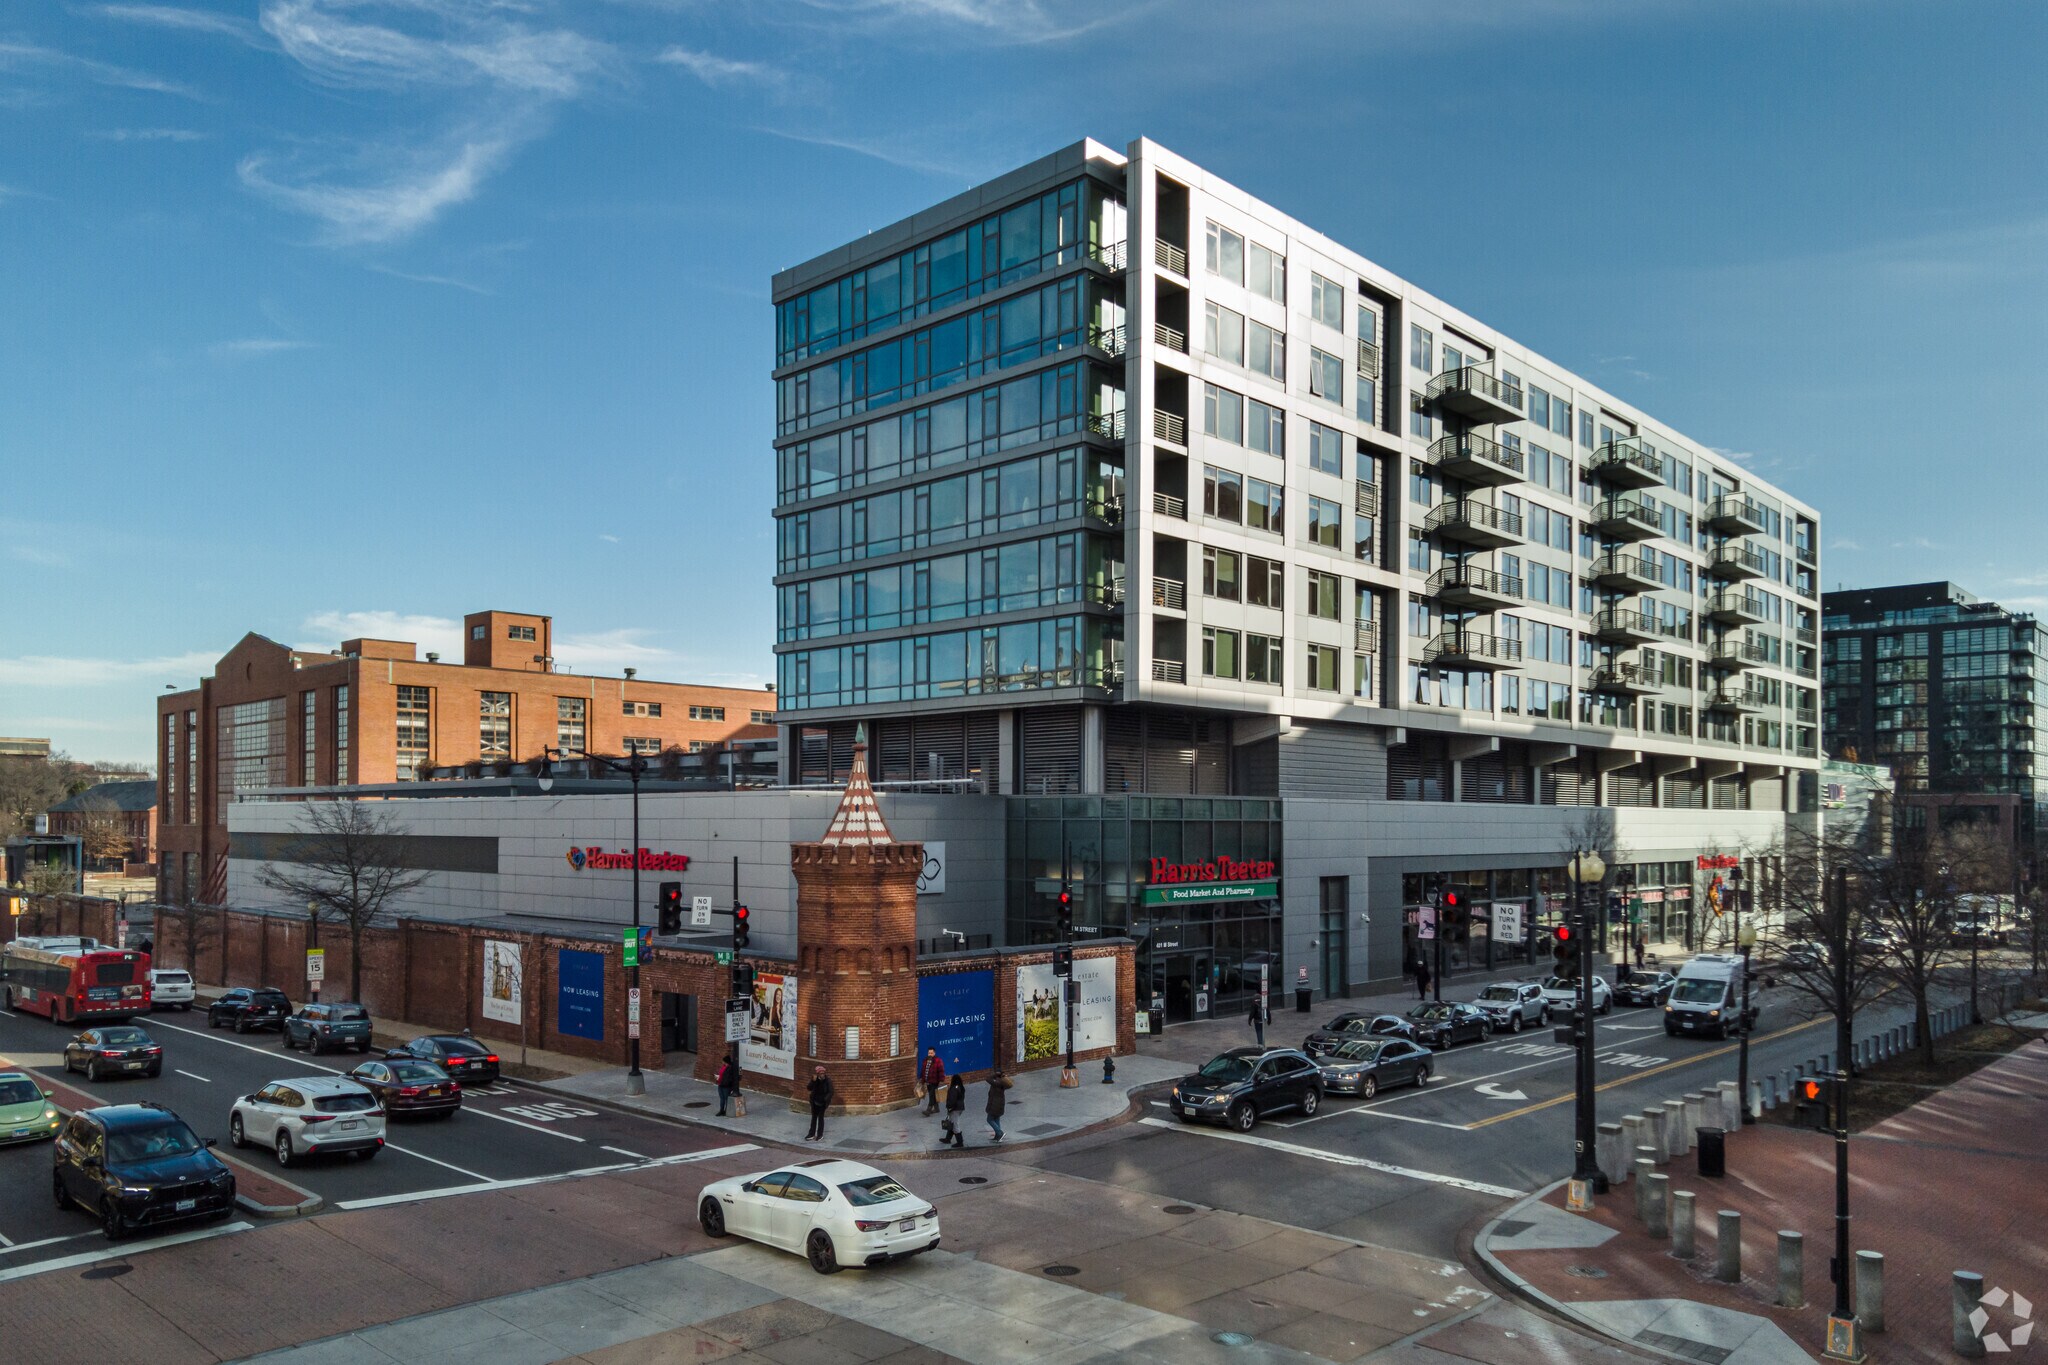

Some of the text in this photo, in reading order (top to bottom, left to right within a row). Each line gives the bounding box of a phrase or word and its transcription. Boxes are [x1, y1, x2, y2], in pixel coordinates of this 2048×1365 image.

[585, 847, 689, 871] Harris Teeter
[1151, 855, 1275, 884] Harris Teeter
[1173, 887, 1255, 898] Food Market And Pharmacy
[1500, 906, 1514, 915] NO
[1498, 915, 1516, 923] TURN
[717, 952, 724, 960] M
[311, 964, 321, 972] 15
[1077, 972, 1099, 980] estate
[562, 986, 599, 997] NOW LEASING
[943, 988, 970, 997] estate
[1082, 995, 1112, 1006] LEASING
[926, 1013, 986, 1029] NOW LEASING
[745, 1049, 763, 1059] Luxury
[762, 1052, 788, 1064] Residences
[500, 1102, 599, 1122] BUS
